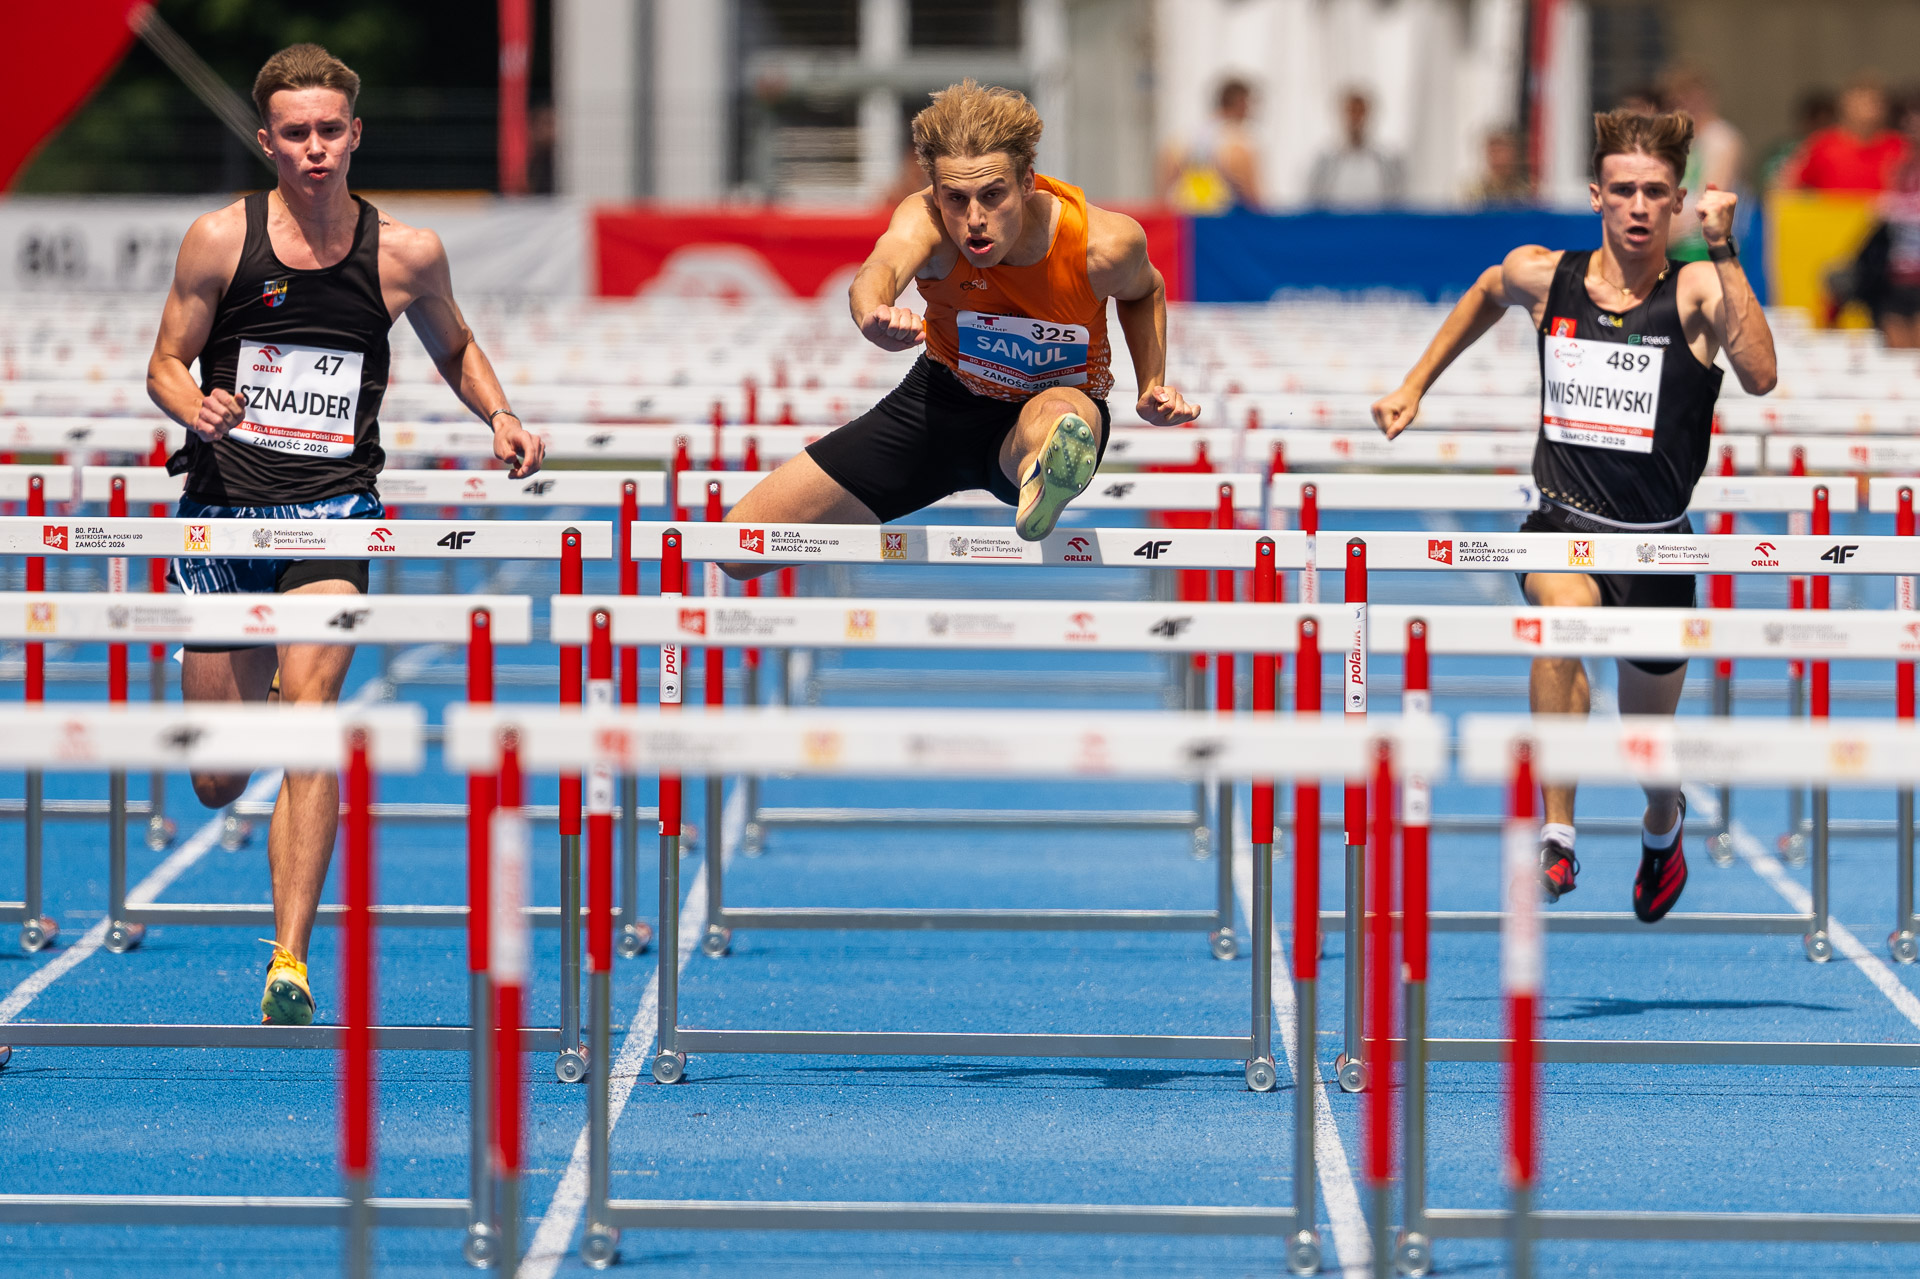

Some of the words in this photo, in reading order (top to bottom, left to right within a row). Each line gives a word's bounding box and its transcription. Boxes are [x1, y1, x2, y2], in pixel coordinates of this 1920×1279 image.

[1031, 324, 1076, 342] 325
[977, 336, 1068, 367] SAMUL
[252, 364, 282, 374] ORLEN
[314, 355, 344, 376] 47
[1606, 351, 1650, 373] 489
[982, 369, 1030, 389] ZAMOŚĆ
[1032, 380, 1060, 390] 2026
[1061, 367, 1075, 376] U20
[240, 384, 351, 420] SZNAJDER
[1547, 378, 1653, 414] WIŚNIEWSKI
[241, 422, 252, 431] 80.
[253, 425, 268, 433] PZLA
[269, 427, 311, 438] Mistrzostwa
[311, 433, 330, 441] Polski
[253, 437, 301, 450] ZAMOŚĆ
[303, 443, 329, 454] 2026
[75, 540, 107, 548] ZAMOŚĆ
[185, 543, 209, 551] PZLA
[274, 537, 294, 545] Sportu
[299, 537, 326, 545] Turystyki
[436, 530, 476, 550] 4F
[771, 544, 803, 553] ZAMOŚĆ
[882, 551, 905, 559] PZLA
[1063, 554, 1092, 562] ORLEN
[1133, 540, 1172, 560] 4F
[1459, 554, 1491, 562] ZAMOŚĆ
[1658, 552, 1678, 560] Sportu
[1820, 545, 1859, 564] 4F
[1569, 557, 1593, 566] PZLA
[664, 642, 678, 675] pola
